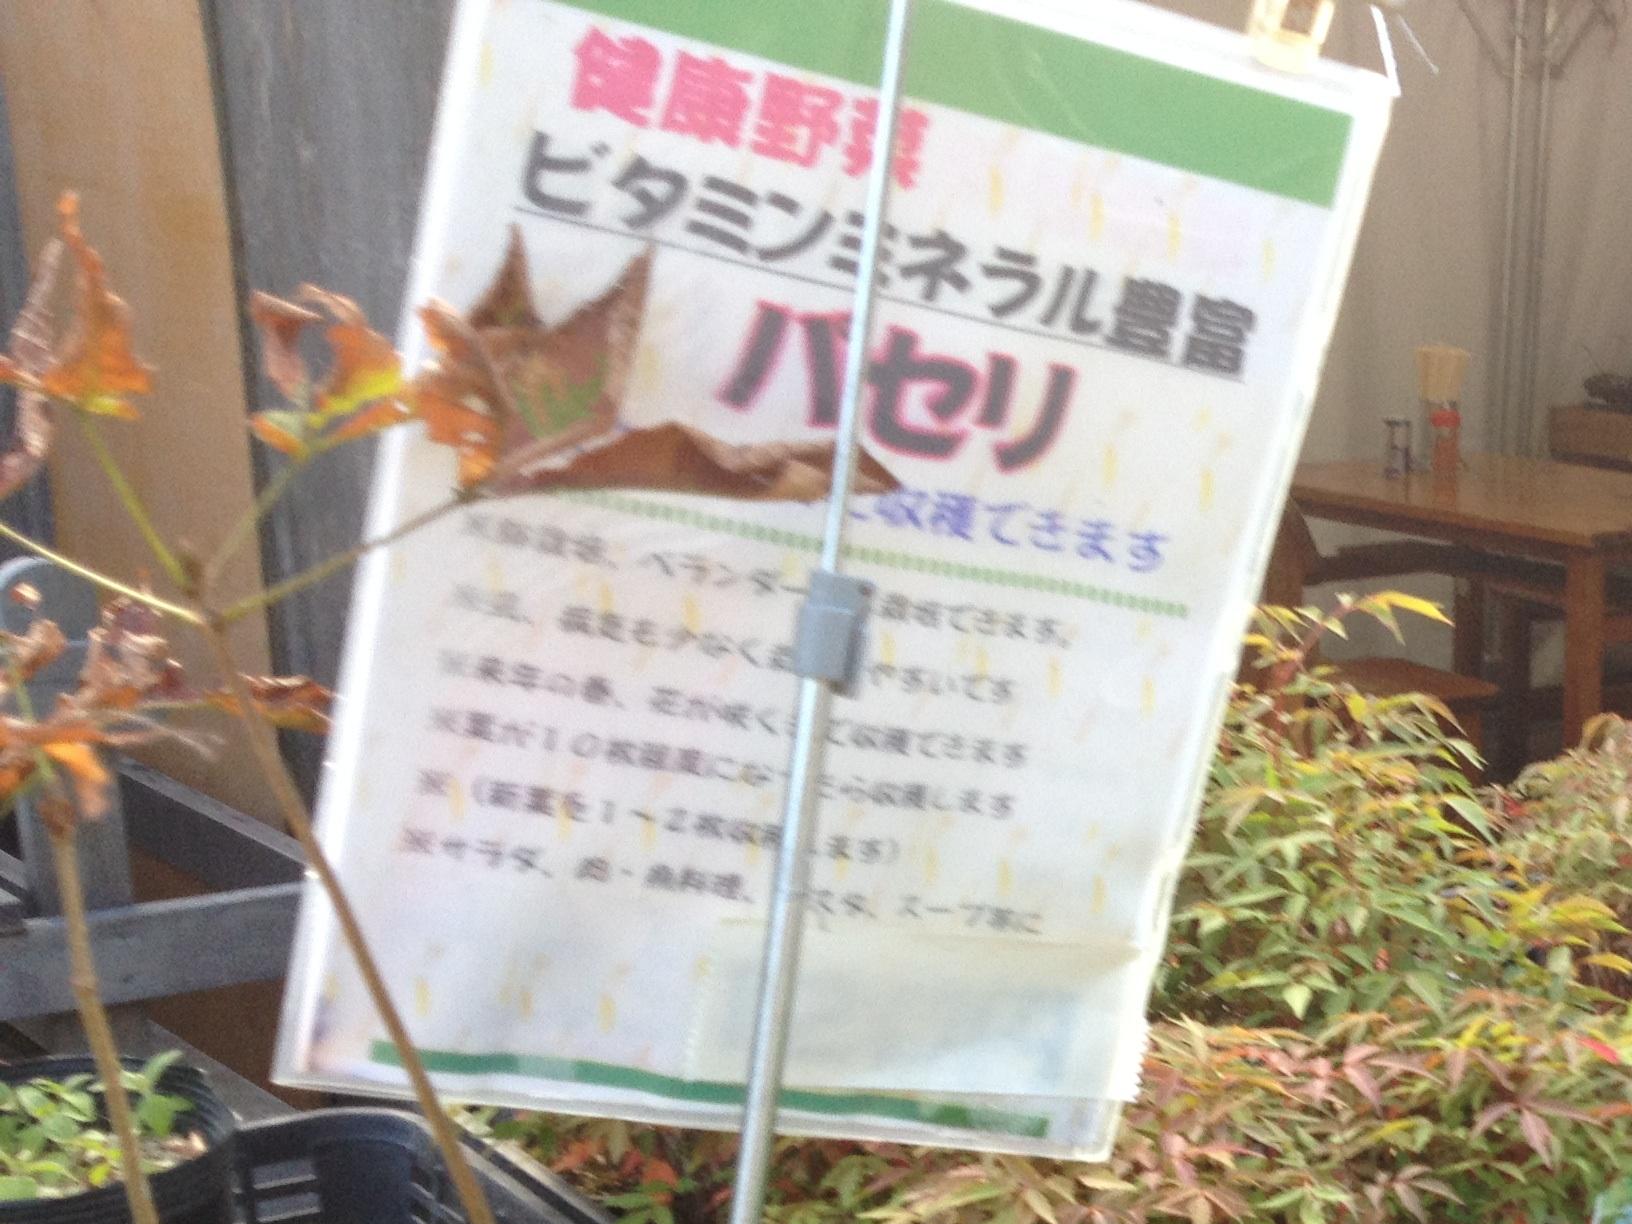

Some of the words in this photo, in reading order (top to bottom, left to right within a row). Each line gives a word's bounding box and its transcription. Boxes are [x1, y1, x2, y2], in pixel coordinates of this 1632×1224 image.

[571, 25, 930, 190] 健康野菜
[525, 131, 1257, 377] ビタミンミネラル豊富
